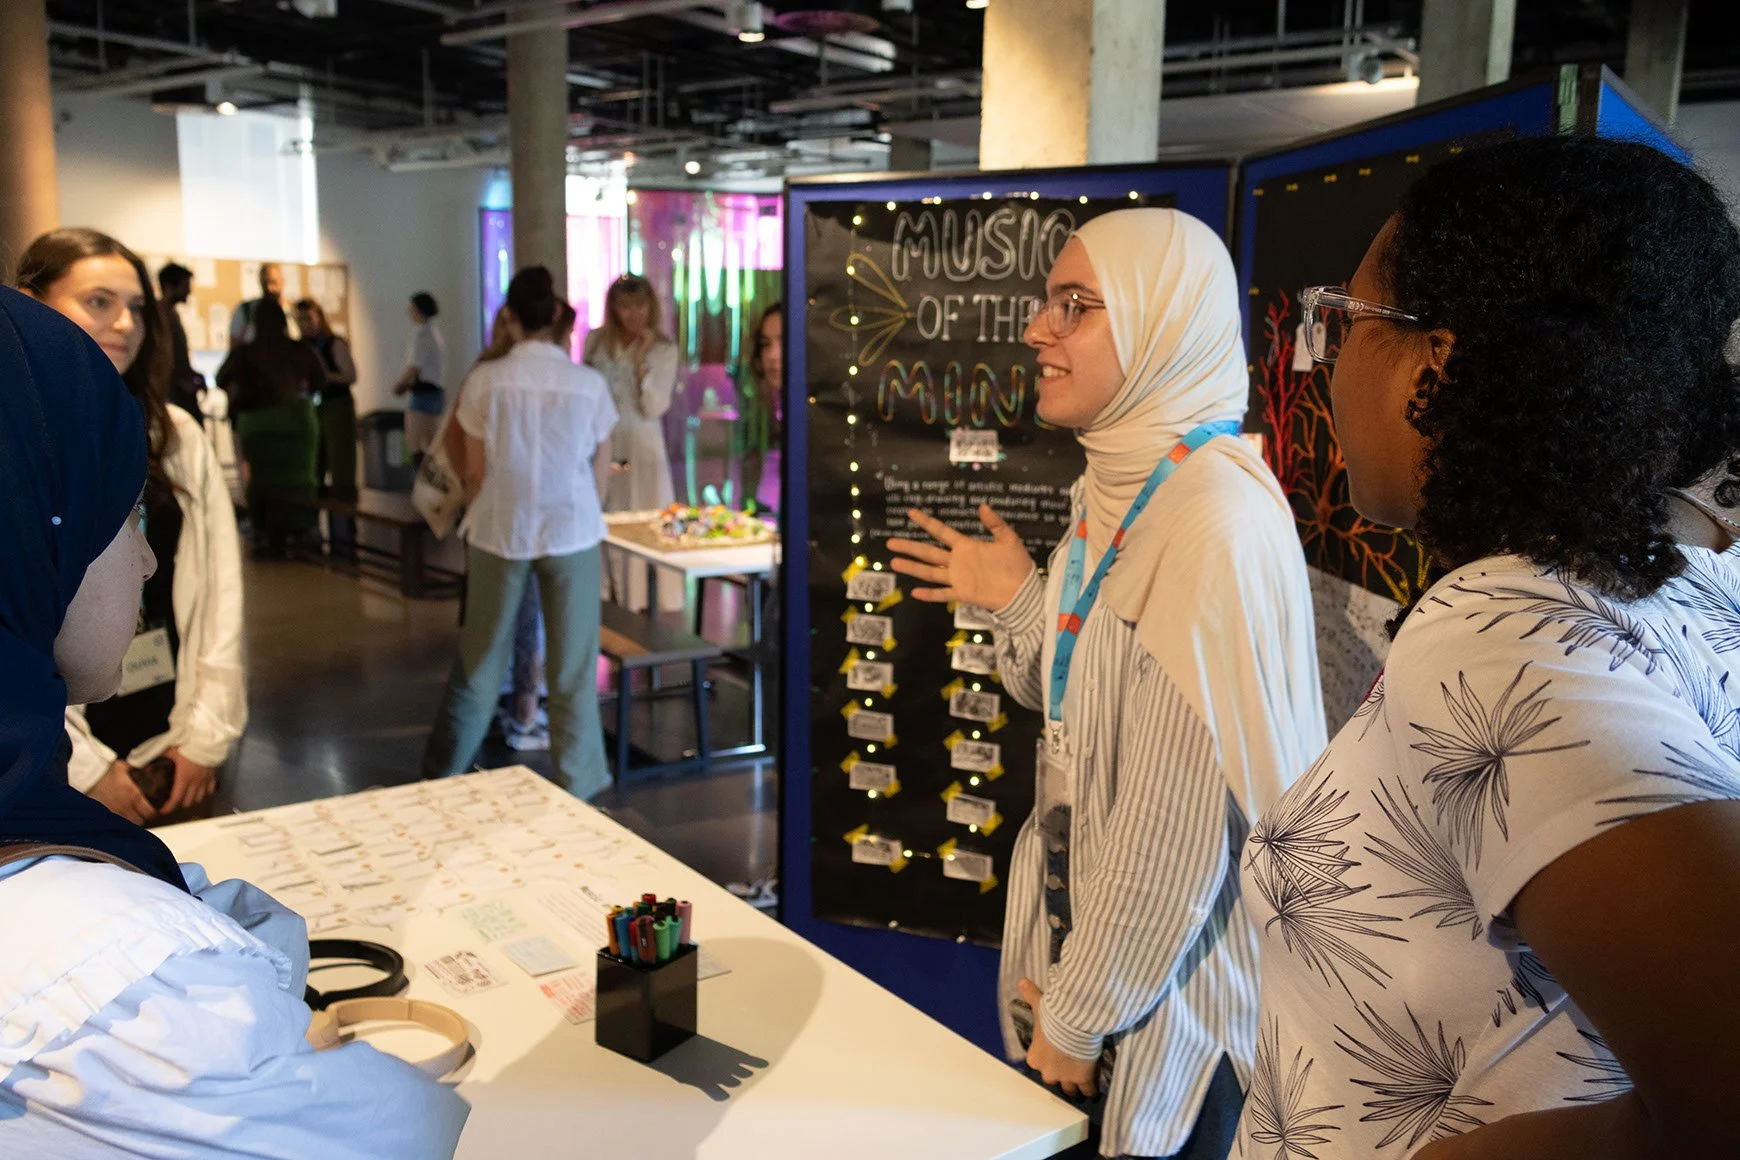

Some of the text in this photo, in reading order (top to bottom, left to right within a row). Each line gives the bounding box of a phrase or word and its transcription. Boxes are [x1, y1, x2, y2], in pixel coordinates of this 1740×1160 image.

[891, 208, 1076, 281] MUSIC
[917, 295, 964, 340] OF
[877, 359, 1057, 431] MIN
